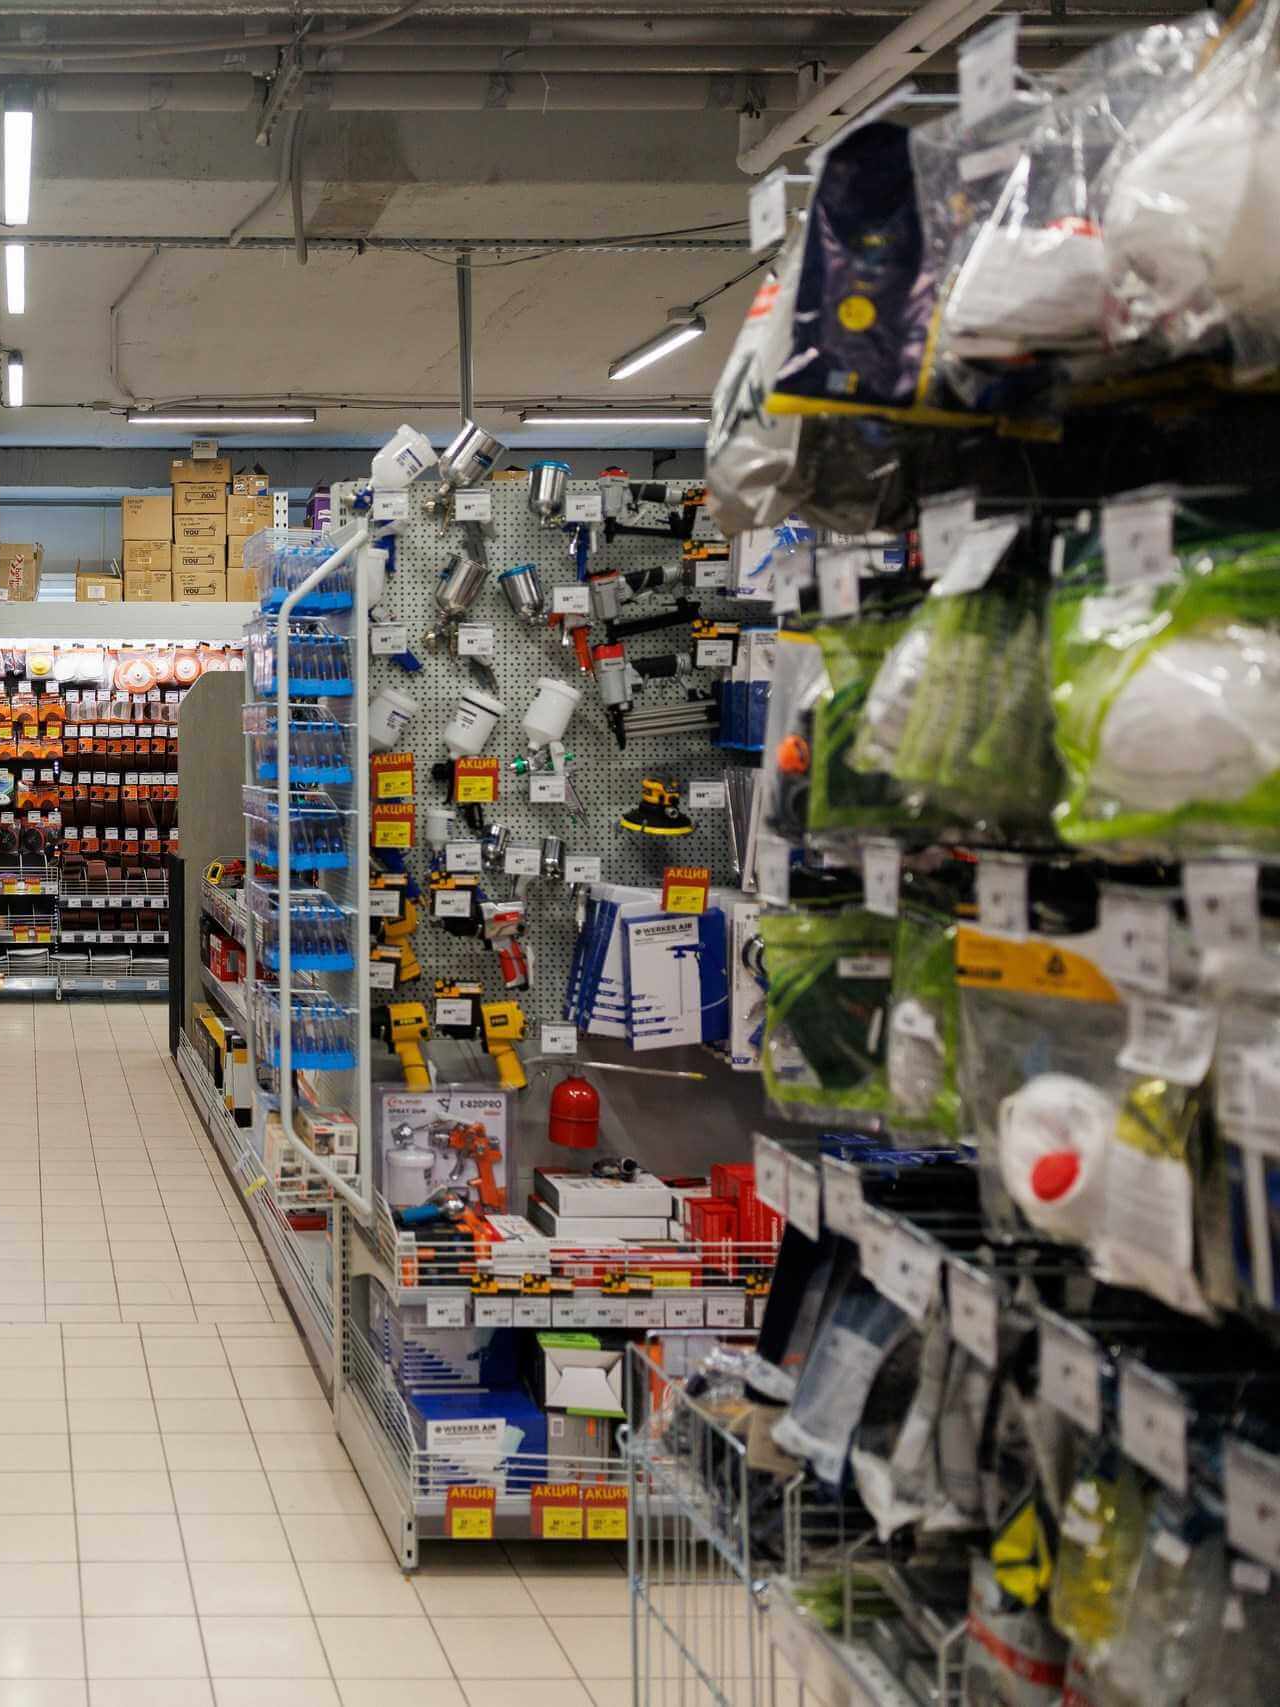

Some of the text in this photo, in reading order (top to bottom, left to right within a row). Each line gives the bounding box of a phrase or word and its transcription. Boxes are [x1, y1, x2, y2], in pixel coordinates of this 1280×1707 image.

[374, 753, 412, 766] АКЦИЯ
[458, 758, 497, 769] АКЦИЯ
[374, 803, 414, 815] АКЦИЯ
[668, 868, 708, 880] АКЦИЯ
[642, 922, 693, 934] WERKER AIR
[443, 1424, 497, 1433] WERKER AIR
[451, 1487, 494, 1499] АКЦИЯ
[534, 1485, 578, 1497] АКЦИЯ
[585, 1486, 628, 1499] АКЦИЯ
